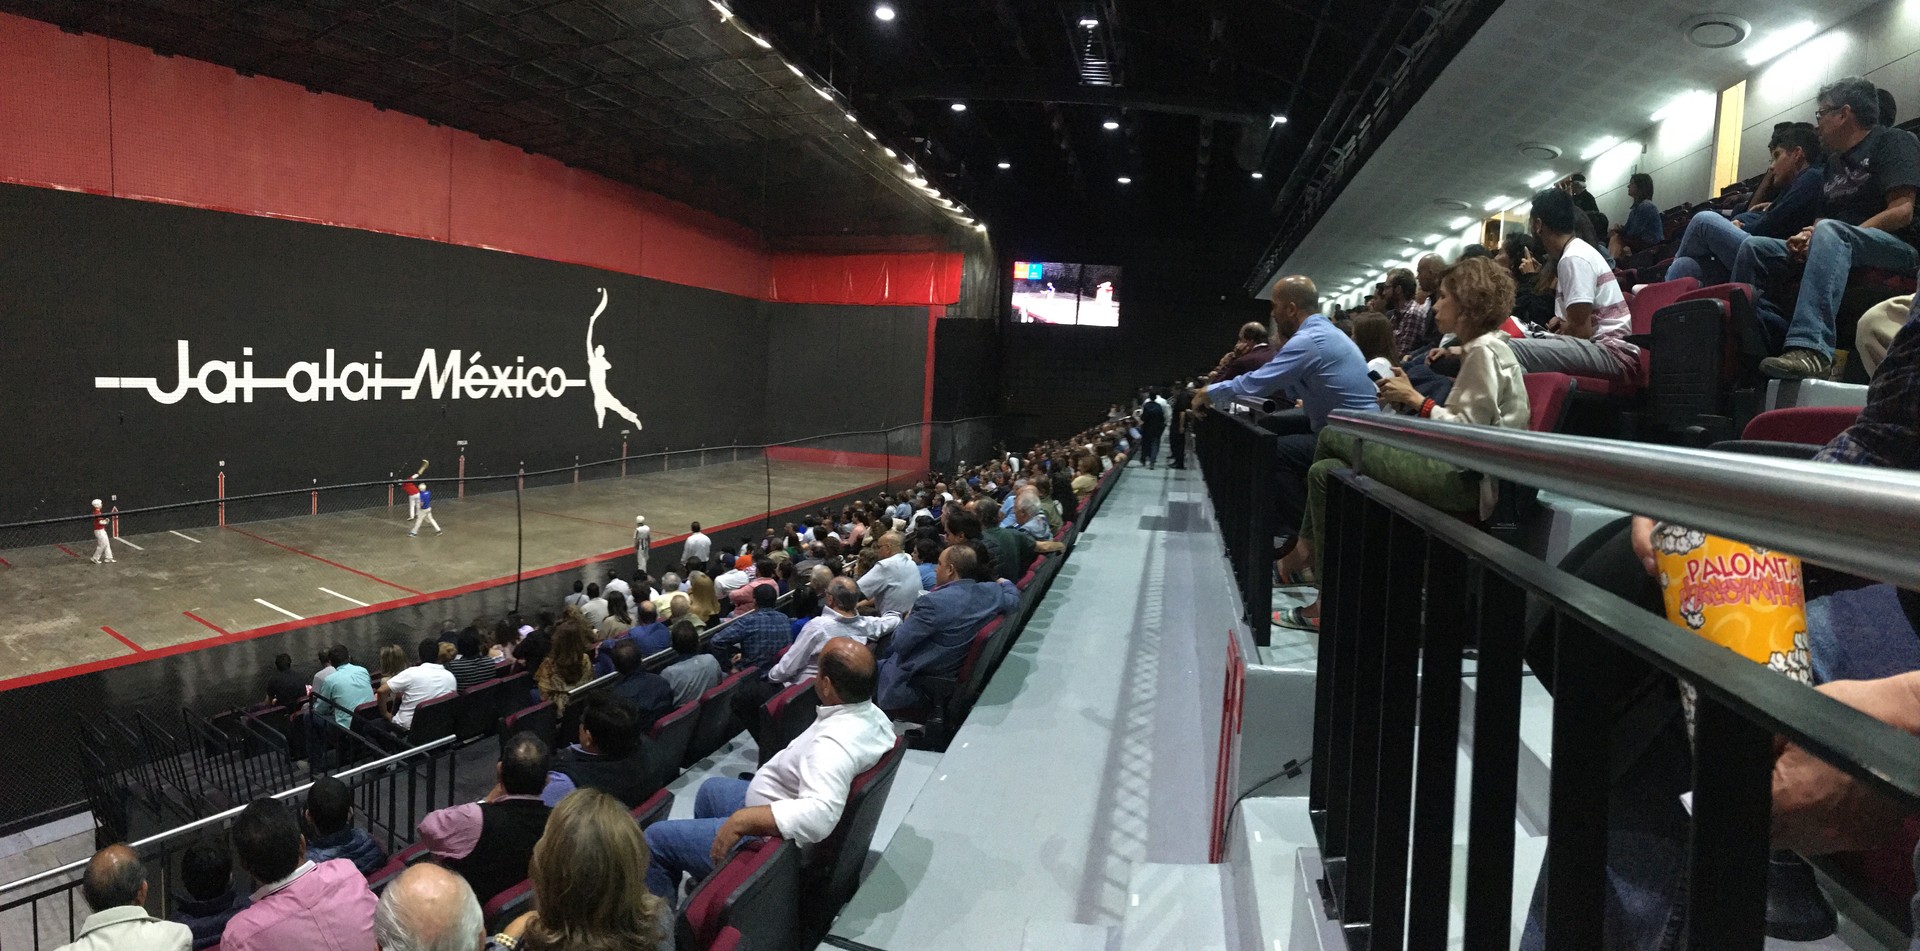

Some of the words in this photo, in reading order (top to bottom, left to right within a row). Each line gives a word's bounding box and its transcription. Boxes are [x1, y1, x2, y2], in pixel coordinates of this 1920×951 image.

[147, 339, 254, 404] Jai
[285, 348, 383, 402] alai
[401, 348, 567, 400] México
